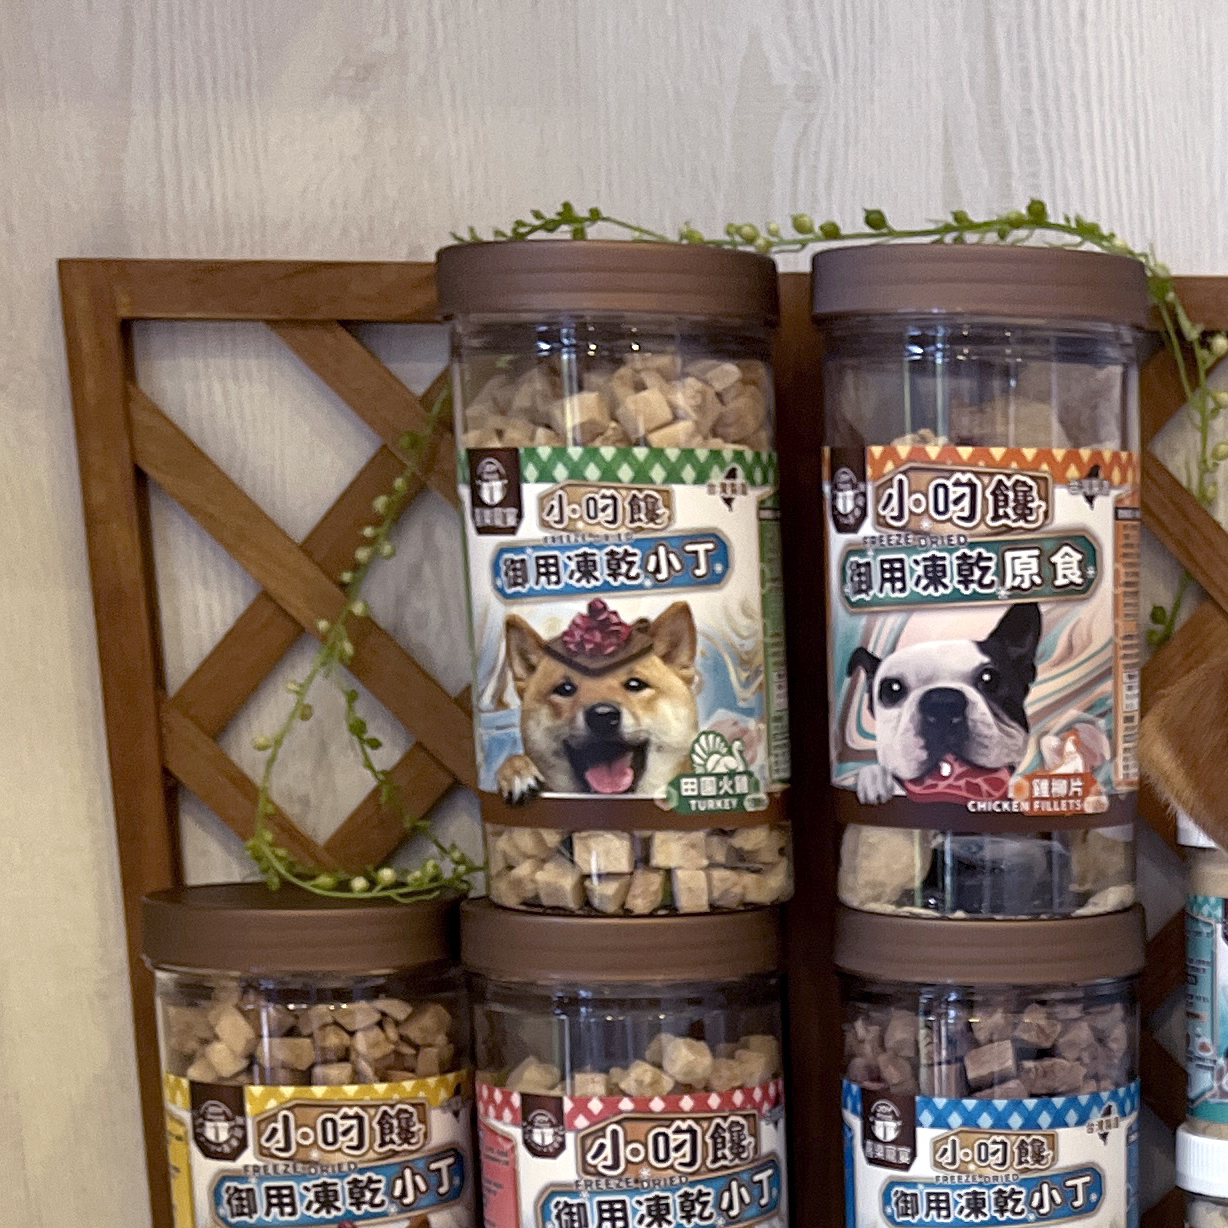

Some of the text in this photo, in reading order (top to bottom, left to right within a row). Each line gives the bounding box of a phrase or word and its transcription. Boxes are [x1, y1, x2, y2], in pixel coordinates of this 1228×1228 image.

[862, 534, 968, 548] FREEZE DRIED
[501, 540, 717, 591] 御用凍乾小丁
[847, 545, 1086, 601] 御用凍乾原食
[689, 798, 738, 812] TURKEY
[966, 799, 1082, 813] CHICKEN FILLETS
[243, 1160, 358, 1177] FREEZE DRIED
[575, 1175, 689, 1191] FREEZE DRIED
[934, 1172, 1020, 1184] FREEZE DRIED
[225, 1156, 456, 1222] 御用凍乾小丁
[892, 1173, 1092, 1222] 御用凍乾小丁
